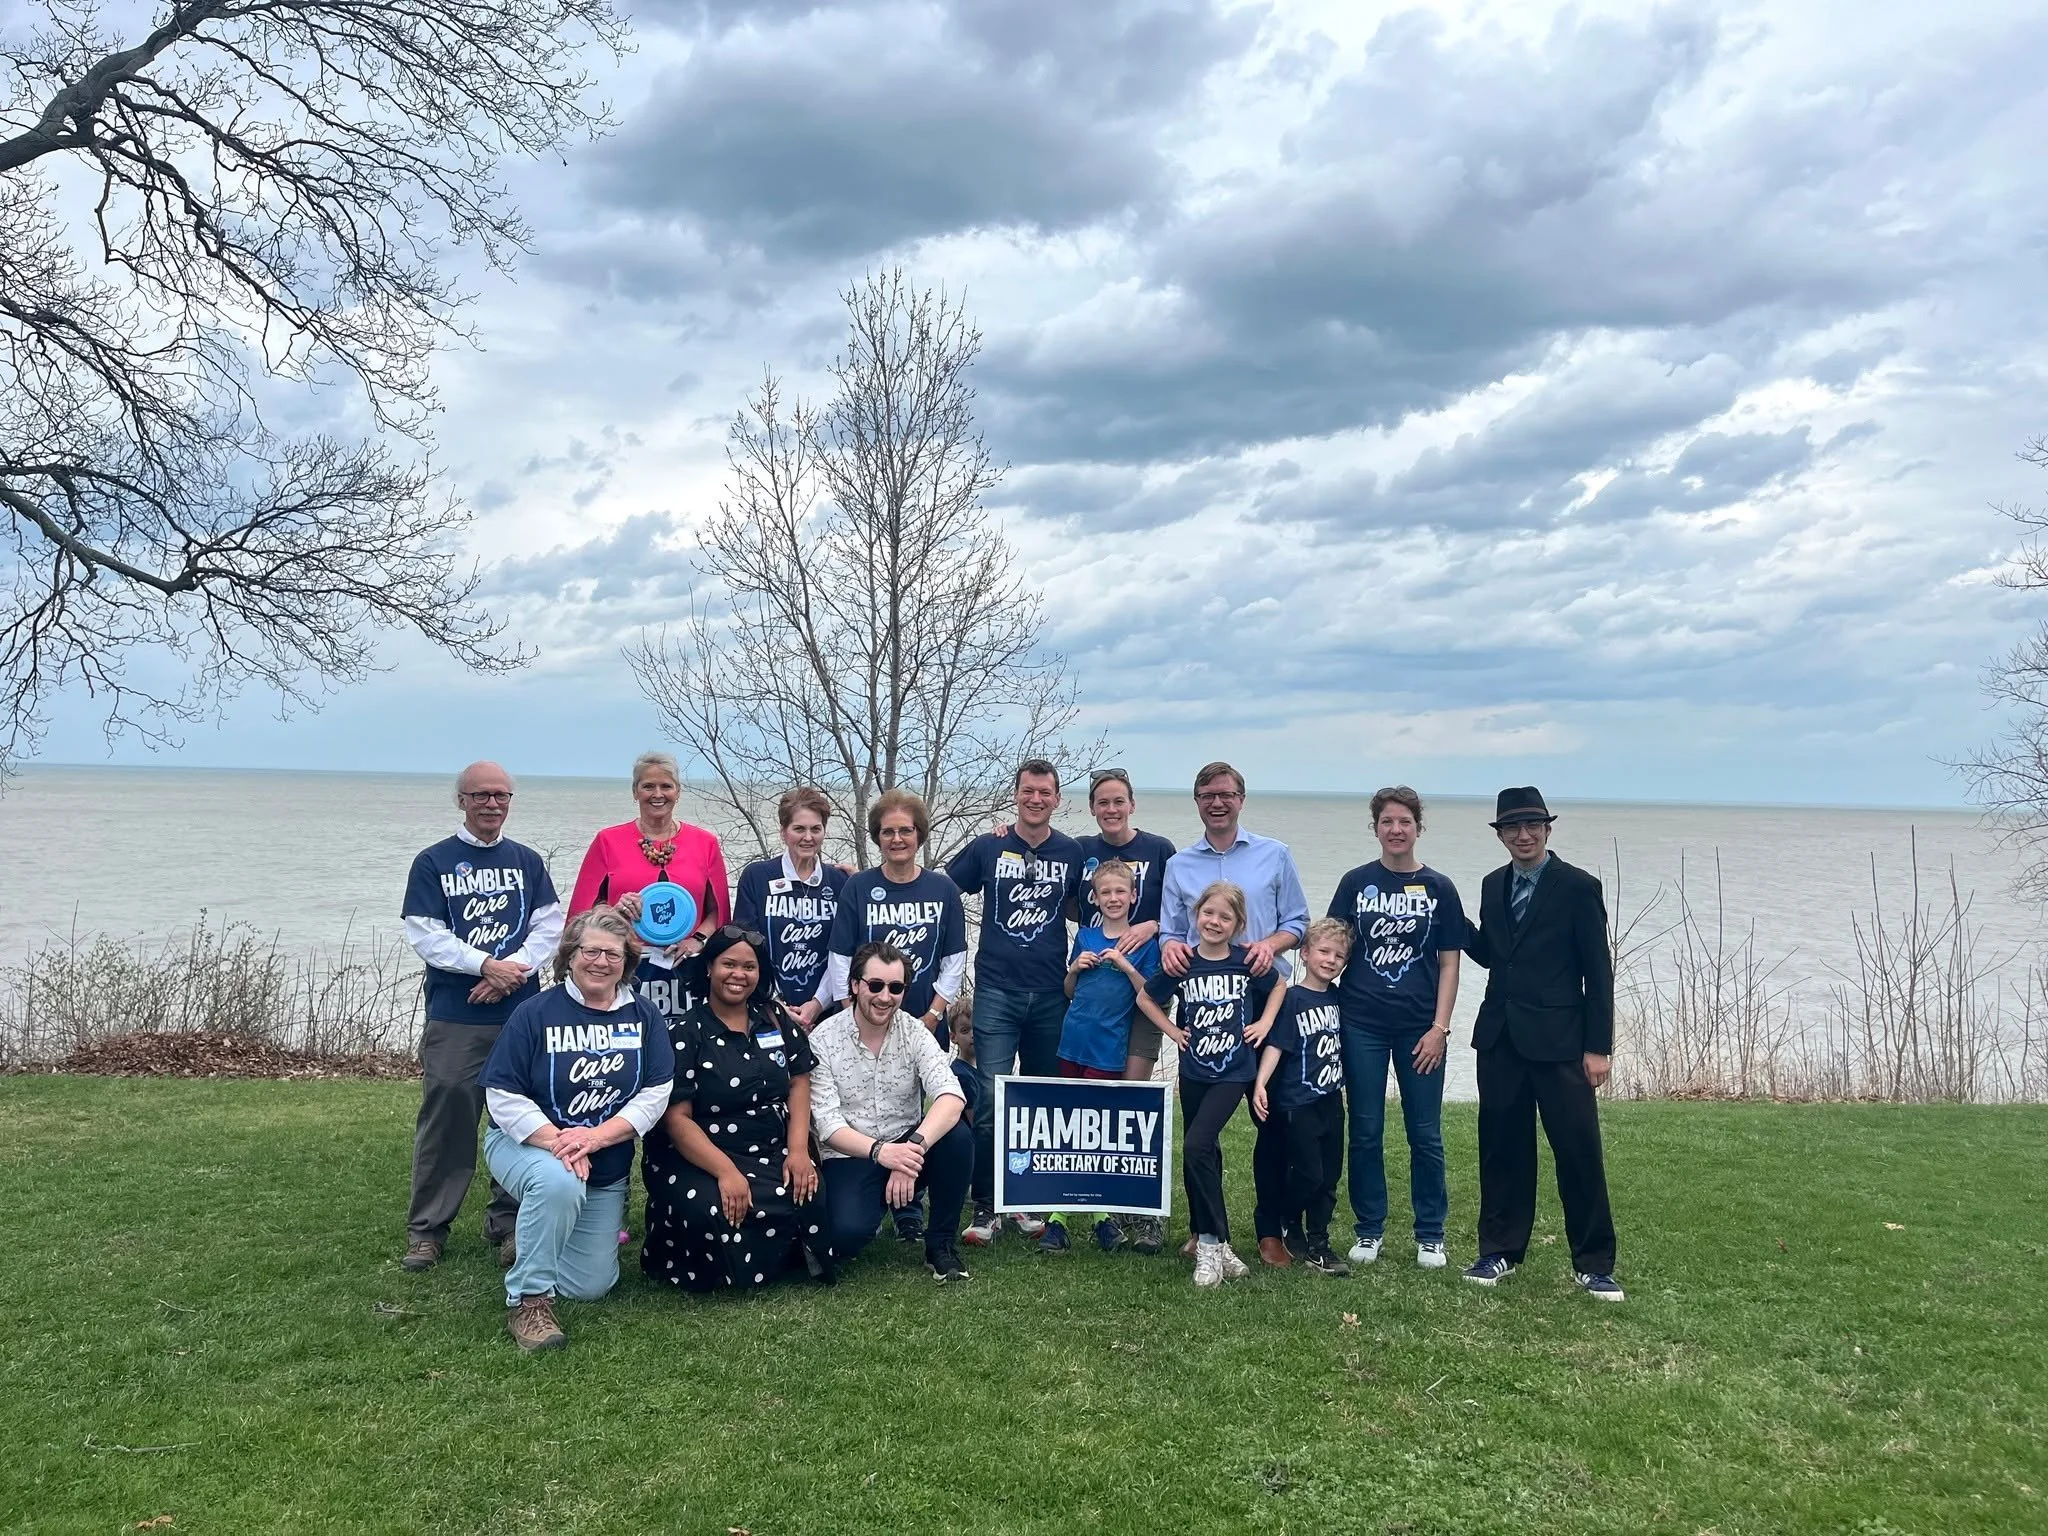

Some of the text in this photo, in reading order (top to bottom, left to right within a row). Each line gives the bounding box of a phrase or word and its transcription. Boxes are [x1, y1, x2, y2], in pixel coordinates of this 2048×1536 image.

[441, 868, 524, 897] HAMBLEY
[1008, 883, 1053, 903] Care
[463, 894, 508, 920] Care
[765, 895, 838, 920] HAMBLEY
[866, 901, 944, 926] HAMBLEY
[1356, 891, 1438, 918] HAMBLEY
[1007, 907, 1048, 929] Ohio
[1370, 917, 1417, 939] Care
[781, 923, 823, 944] Care
[884, 926, 928, 949] Care
[782, 949, 819, 972] Ohio
[1372, 943, 1414, 967] Ohio
[1193, 1002, 1235, 1029] Care
[1196, 1031, 1235, 1057] Ohio
[569, 1053, 625, 1083] Care
[567, 1086, 621, 1116] Ohio
[1008, 1106, 1159, 1153] HAMBLEY
[1032, 1153, 1101, 1172] SECRETARY
[1103, 1155, 1119, 1173] OF
[1121, 1157, 1158, 1176] STATE
